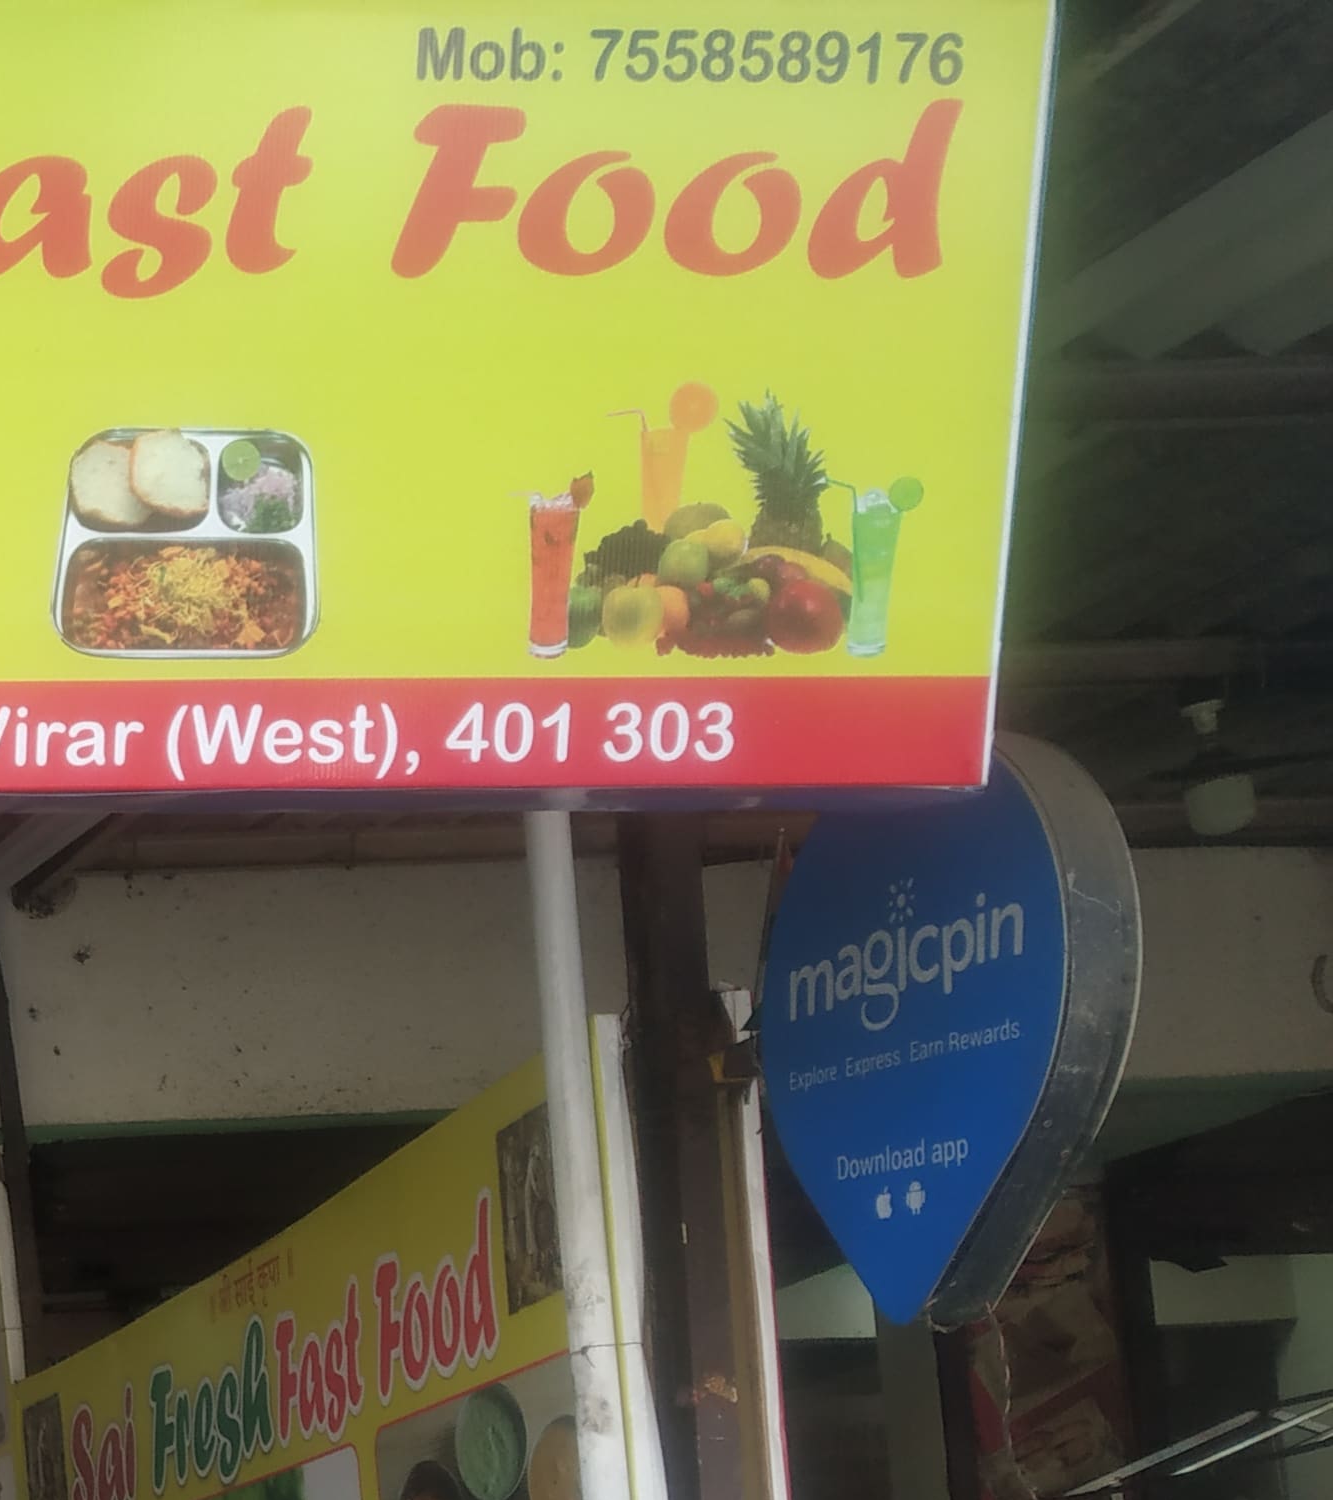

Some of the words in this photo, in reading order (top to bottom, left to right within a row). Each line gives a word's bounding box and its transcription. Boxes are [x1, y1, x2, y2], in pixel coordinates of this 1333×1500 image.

[415, 27, 564, 84] Mob:
[591, 28, 965, 87] 7558589176
[390, 98, 964, 281] Food
[165, 702, 421, 782] (West),
[444, 701, 571, 763] 401
[602, 701, 735, 763] 303
[789, 890, 1025, 1031] magicpin
[836, 1139, 926, 1181] Download
[931, 1137, 969, 1165] app
[150, 1313, 274, 1495] Fresh
[274, 1275, 364, 1447] Fast
[373, 1187, 500, 1412] Food
